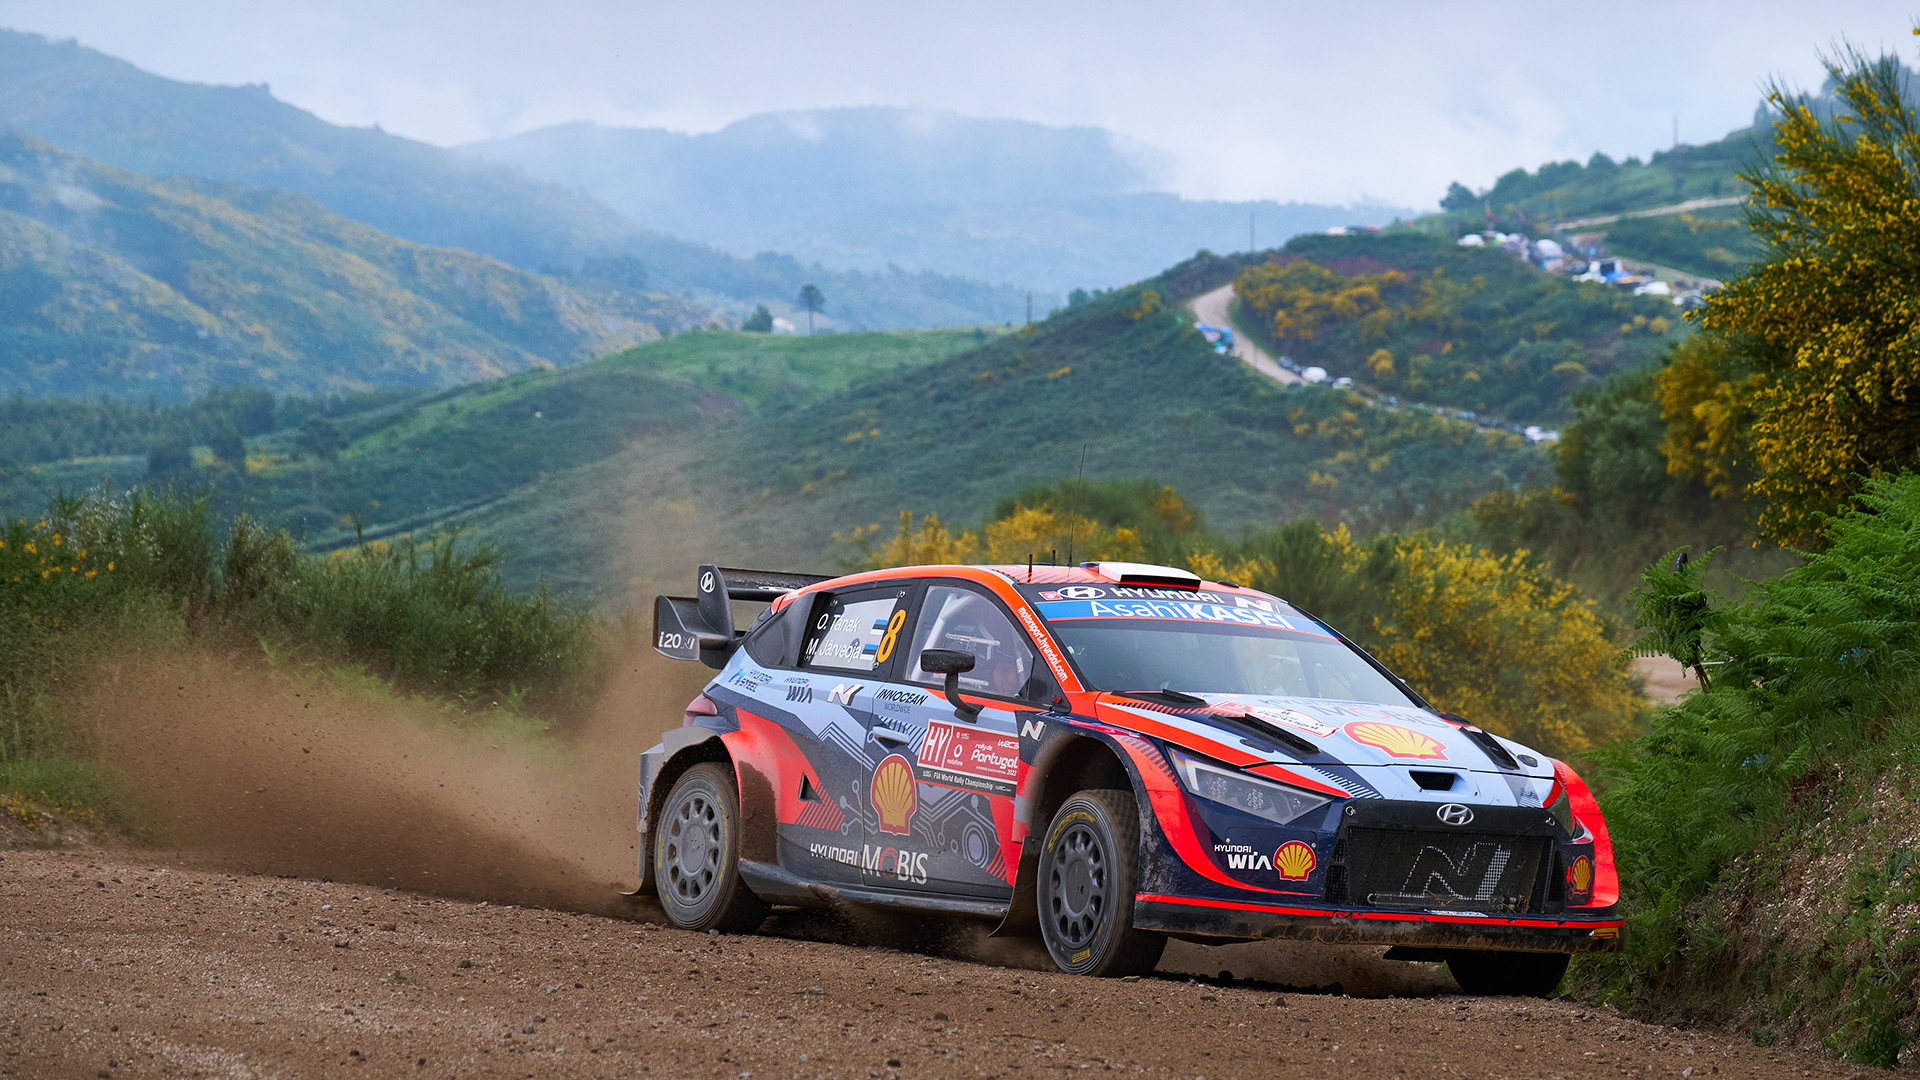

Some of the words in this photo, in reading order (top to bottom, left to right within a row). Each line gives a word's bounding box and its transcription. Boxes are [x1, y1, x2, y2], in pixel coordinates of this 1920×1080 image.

[1110, 587, 1225, 604] HYUNDAI
[817, 613, 829, 630] O.
[830, 614, 861, 633] Tänak
[1090, 600, 1295, 630] AsahiKASEI
[876, 609, 906, 663] 8
[1017, 606, 1068, 682] motorsport.hyundai.com
[805, 638, 820, 656] M.
[819, 639, 861, 663] Järveoja
[738, 677, 759, 693] STEEL
[783, 676, 810, 684] HYUNDAI
[785, 684, 813, 704] WIA
[875, 688, 929, 706] INNOCEAN
[883, 702, 911, 715] WORLDWIDE
[921, 725, 950, 763] HY
[970, 749, 1018, 770] Portugal
[933, 771, 941, 779] FIA
[941, 773, 954, 782] World
[954, 775, 965, 786] Rally
[964, 777, 994, 791] Championship
[1214, 844, 1252, 853] HYUNDAI
[810, 843, 859, 866] HYUNDAI
[861, 844, 929, 885] MOBIS
[1227, 851, 1273, 871] WIA
